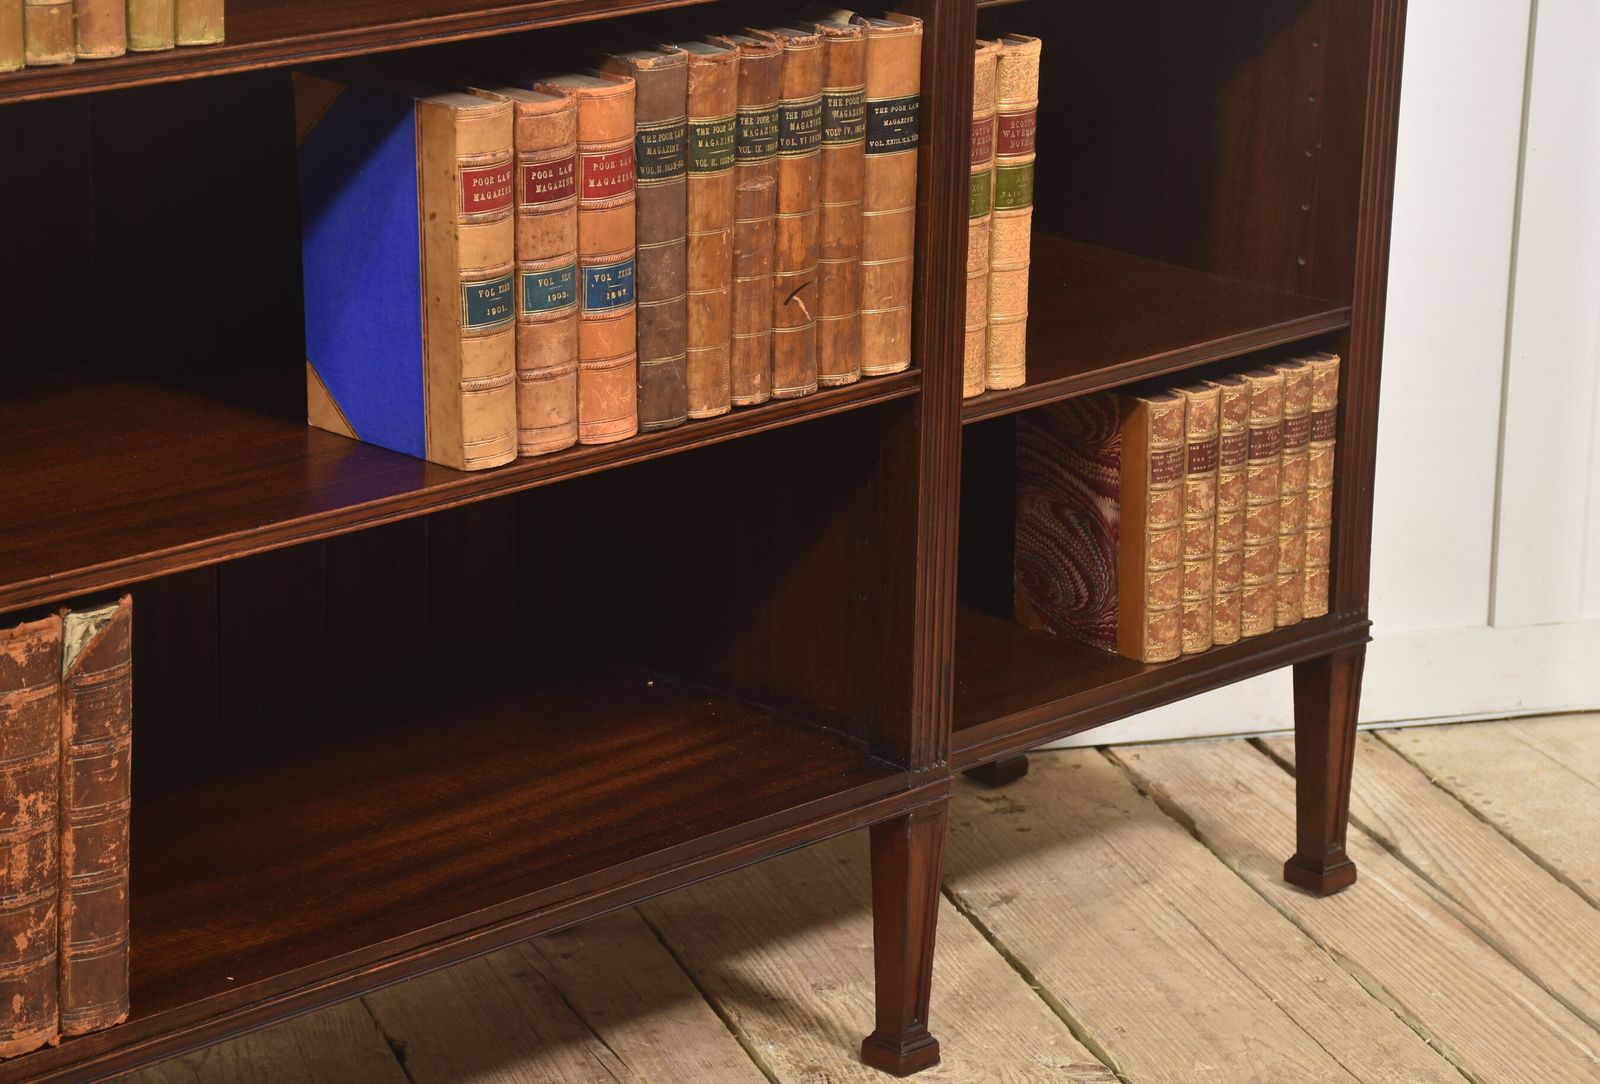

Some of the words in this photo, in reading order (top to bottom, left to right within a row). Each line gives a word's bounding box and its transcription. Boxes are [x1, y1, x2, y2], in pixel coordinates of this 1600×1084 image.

[827, 98, 844, 107] THE
[845, 96, 860, 106] POOR
[785, 111, 798, 120] THE
[800, 109, 814, 119] POOR
[831, 106, 865, 119] MAGAZINE
[874, 106, 888, 115] THE
[890, 105, 907, 113] POOR
[908, 102, 920, 111] LAW
[740, 117, 754, 125] THE
[756, 115, 770, 125] POOR
[789, 117, 822, 131] MAGAZINE
[883, 116, 914, 127] MAGAZINE
[658, 131, 674, 143] POOR
[674, 128, 685, 138] LAW
[696, 127, 710, 136] THE
[713, 126, 727, 135] POOR
[743, 125, 778, 138] MAGAZINE
[697, 135, 735, 148] MAGAZINE
[593, 162, 615, 172] POOR
[620, 157, 632, 167] LAW
[531, 169, 554, 180] POOR
[559, 163, 573, 176] LAW
[472, 175, 495, 187] POOR
[497, 170, 511, 183] LAW
[535, 176, 574, 193] MAGAZINE
[588, 171, 634, 188] MAGAZINE
[473, 185, 512, 202] MAGAZINE
[537, 278, 555, 287] VOL
[478, 288, 496, 299] VOL
